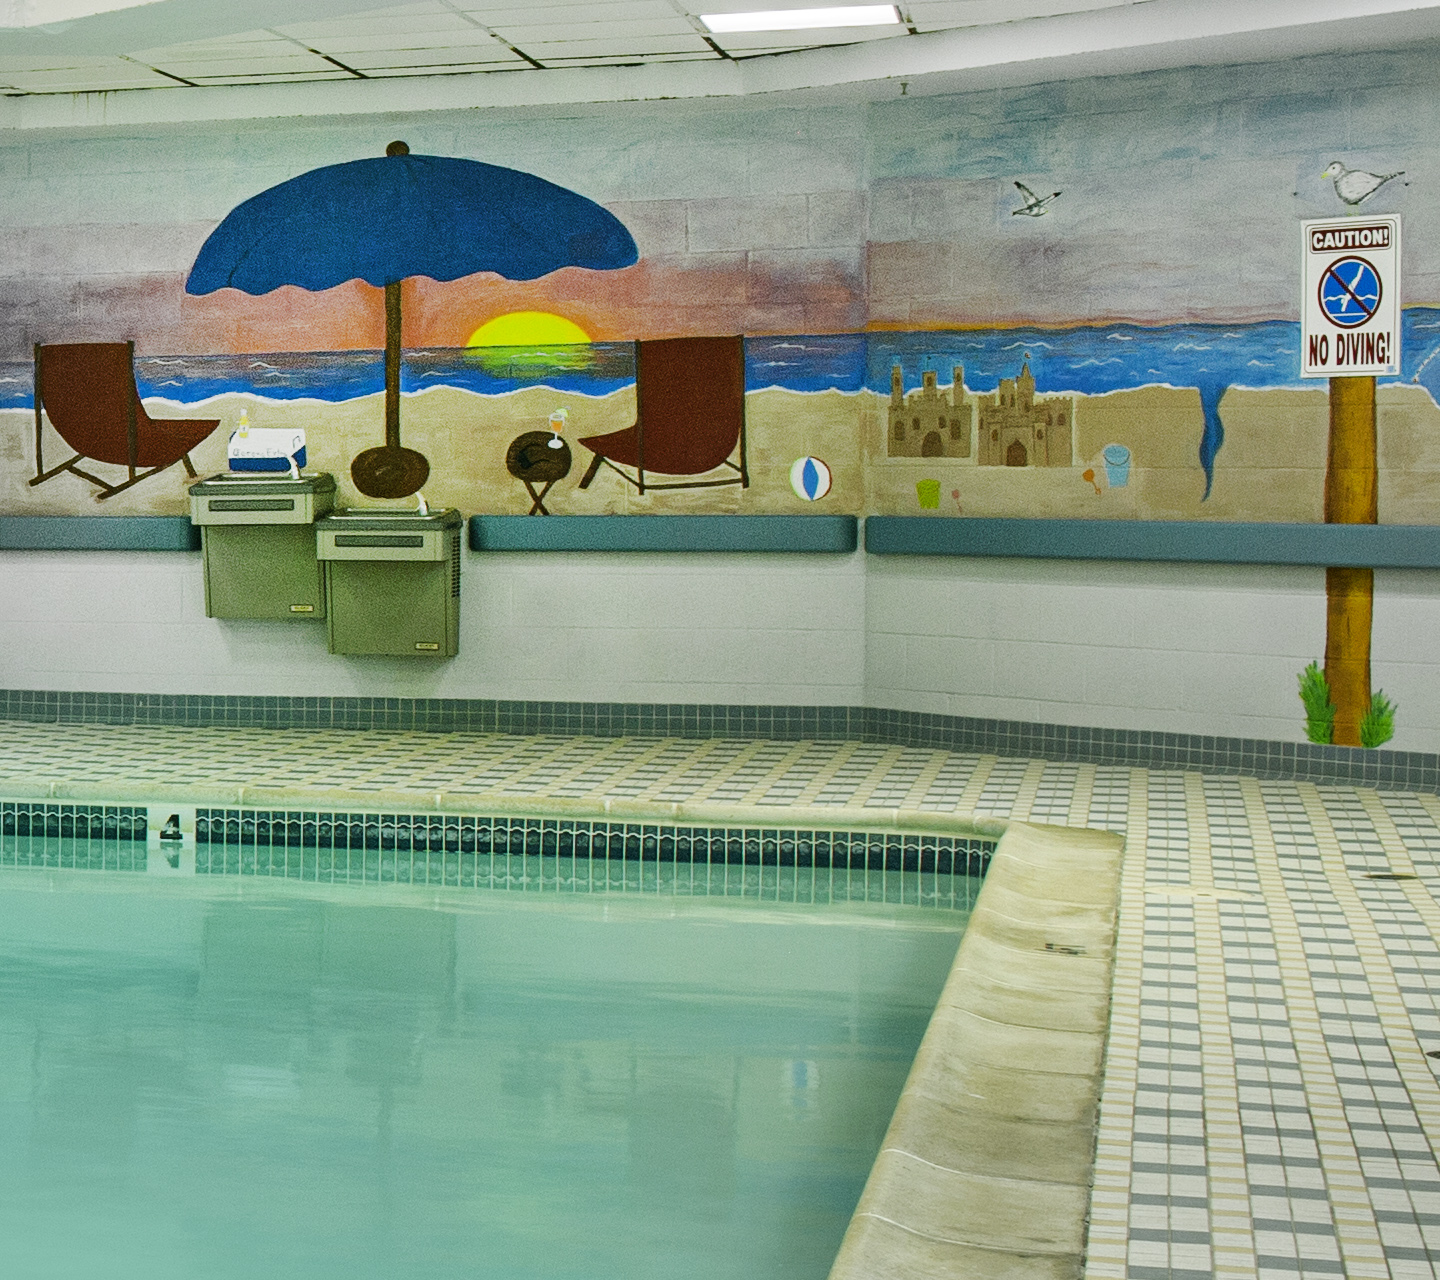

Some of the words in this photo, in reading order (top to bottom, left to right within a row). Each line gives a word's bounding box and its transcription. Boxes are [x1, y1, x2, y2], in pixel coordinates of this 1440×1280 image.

[1312, 228, 1389, 250] CAUTION!
[1309, 334, 1328, 367] NO
[1336, 332, 1391, 366] DIVING!
